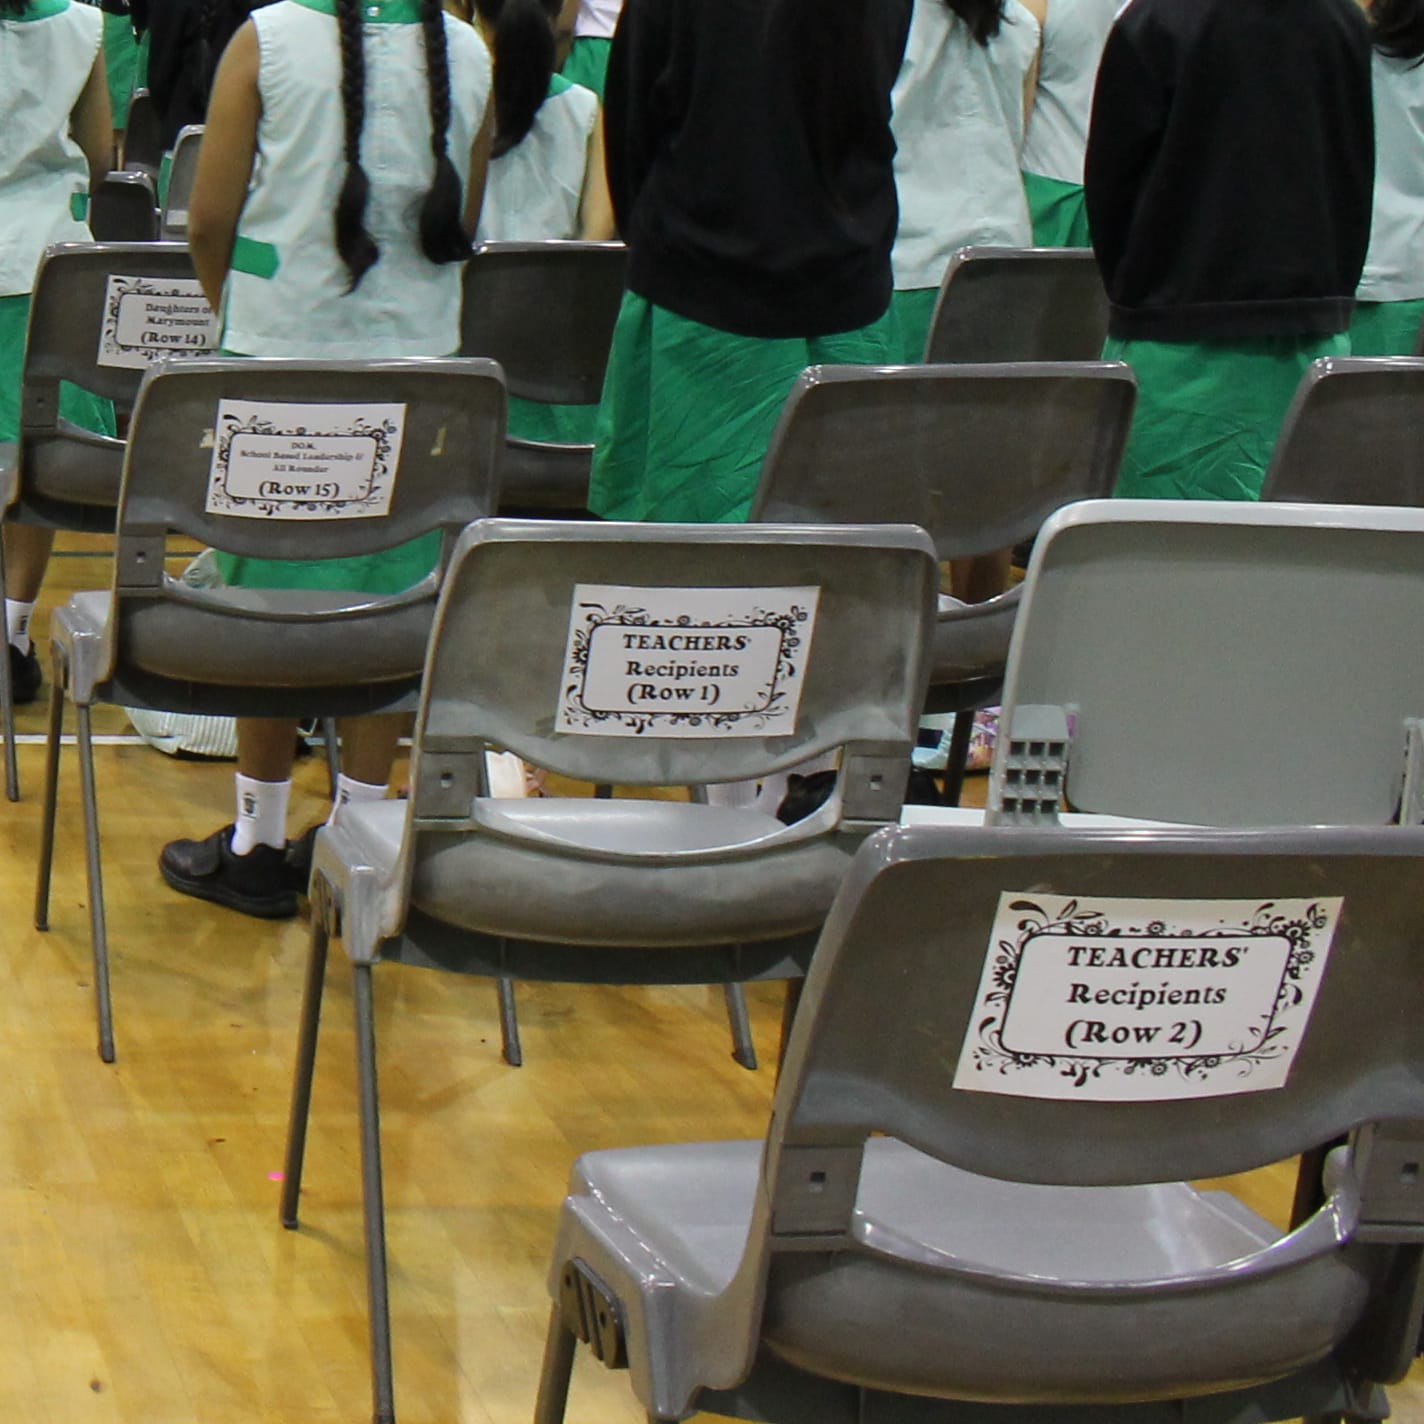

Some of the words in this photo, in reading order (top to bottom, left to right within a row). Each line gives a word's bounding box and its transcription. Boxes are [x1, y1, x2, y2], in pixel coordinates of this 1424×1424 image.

[140, 331, 183, 346] (Row
[184, 334, 206, 346] 14)
[258, 480, 311, 497] (Row
[315, 482, 340, 498] 15)
[626, 660, 739, 680] Recipients
[627, 684, 695, 705] (Row
[701, 684, 720, 705] 1)
[1068, 947, 1248, 968] TEACHERS'
[1067, 982, 1226, 1010] Recipients
[1065, 1020, 1161, 1048] (Row
[1169, 1020, 1202, 1049] 2)
